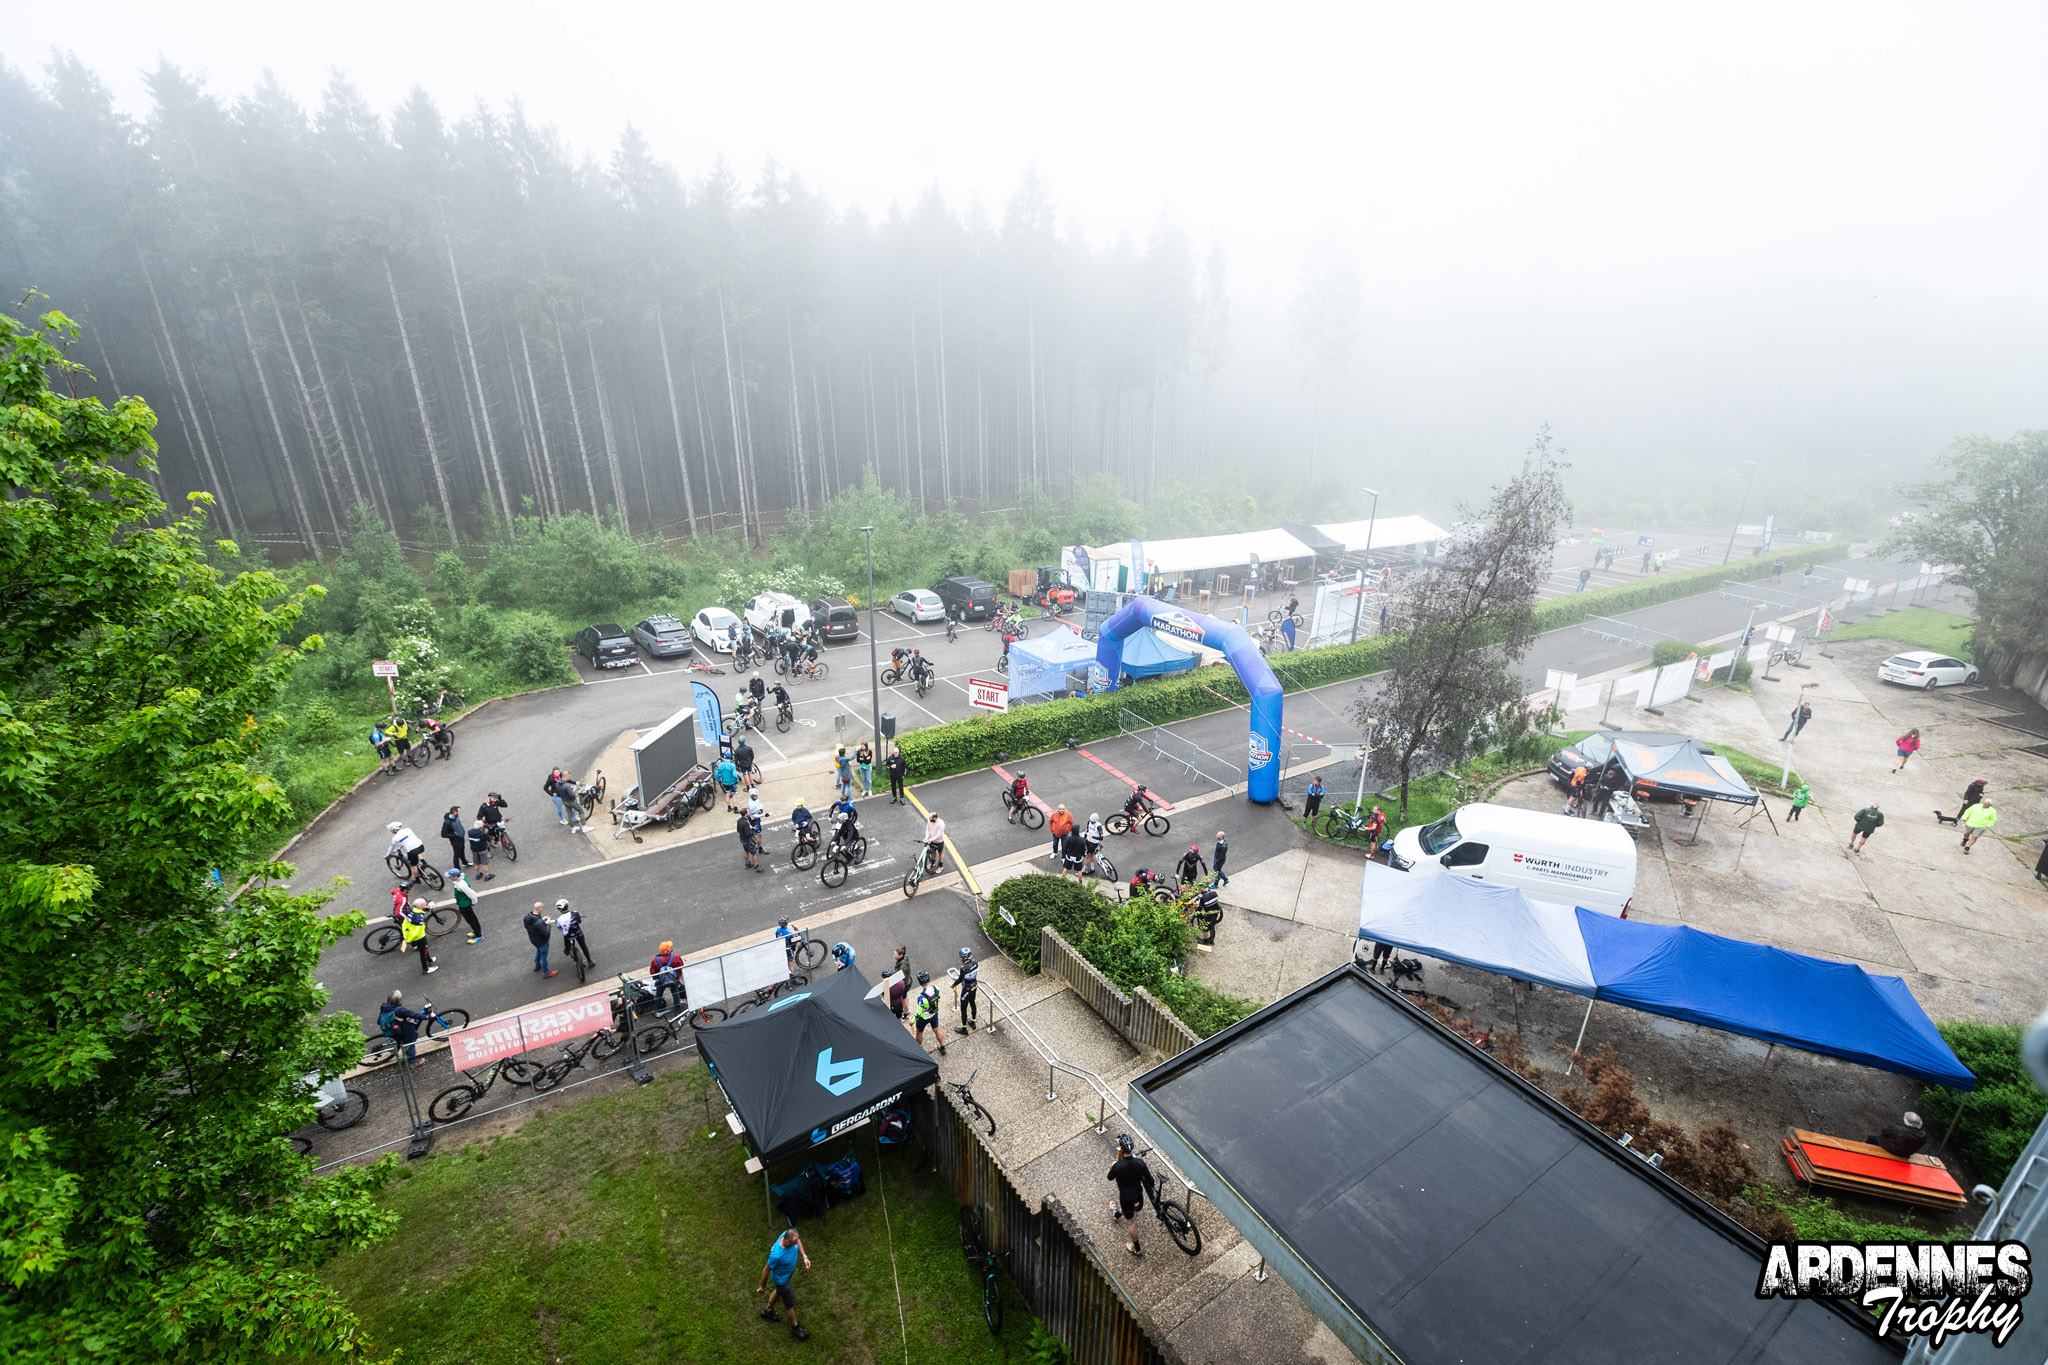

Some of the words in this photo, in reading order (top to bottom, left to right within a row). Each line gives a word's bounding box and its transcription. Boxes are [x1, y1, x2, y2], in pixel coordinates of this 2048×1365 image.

[1153, 620, 1199, 641] MARATHON
[977, 688, 999, 703] START
[1526, 865, 1549, 873] C-PARTS
[1550, 869, 1593, 881] MANAGEMENT
[1564, 863, 1609, 877] INDUSTRY
[831, 1091, 903, 1135] BERGAMONT
